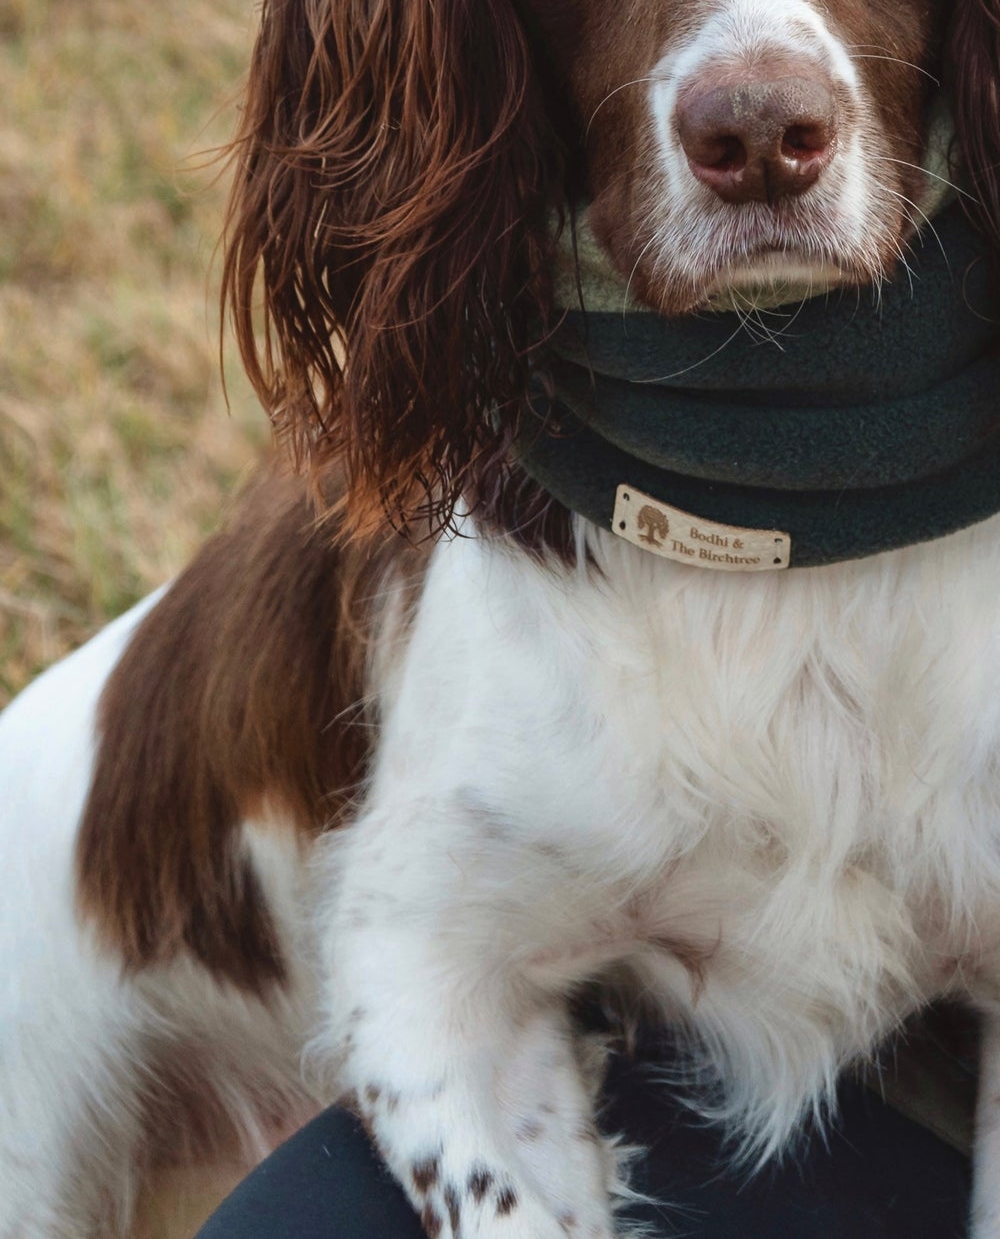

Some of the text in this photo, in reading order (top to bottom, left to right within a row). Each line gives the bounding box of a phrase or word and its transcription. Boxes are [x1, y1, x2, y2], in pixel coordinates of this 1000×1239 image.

[690, 527, 745, 549] Bodhi &
[671, 539, 760, 564] The Birchtree
